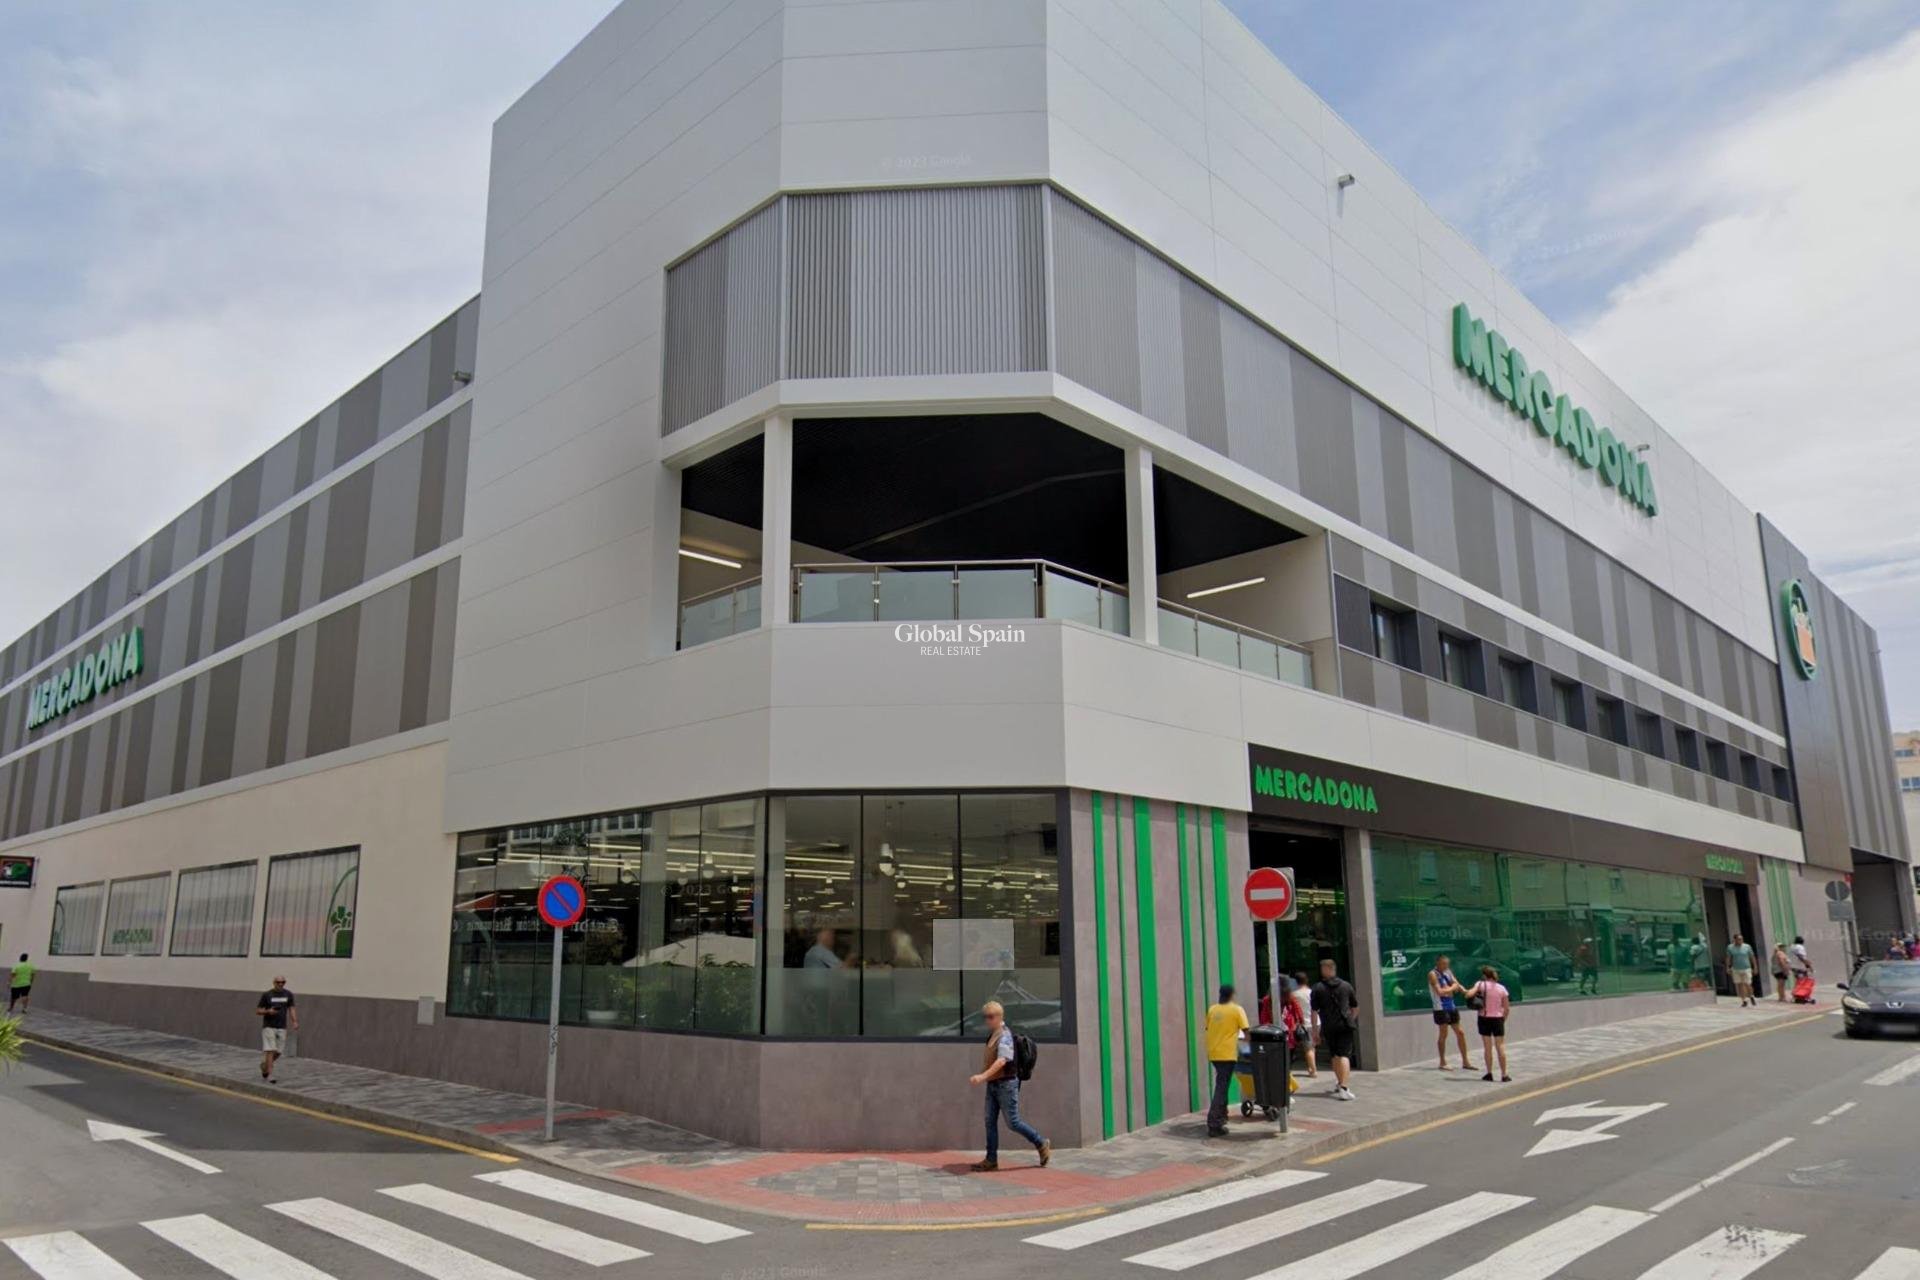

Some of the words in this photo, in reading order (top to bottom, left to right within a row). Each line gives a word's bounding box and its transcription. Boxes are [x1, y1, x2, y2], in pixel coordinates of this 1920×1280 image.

[1453, 302, 1658, 517] MERCADONA
[26, 625, 143, 730] MERCADONA
[1254, 763, 1378, 813] MERCADONA
